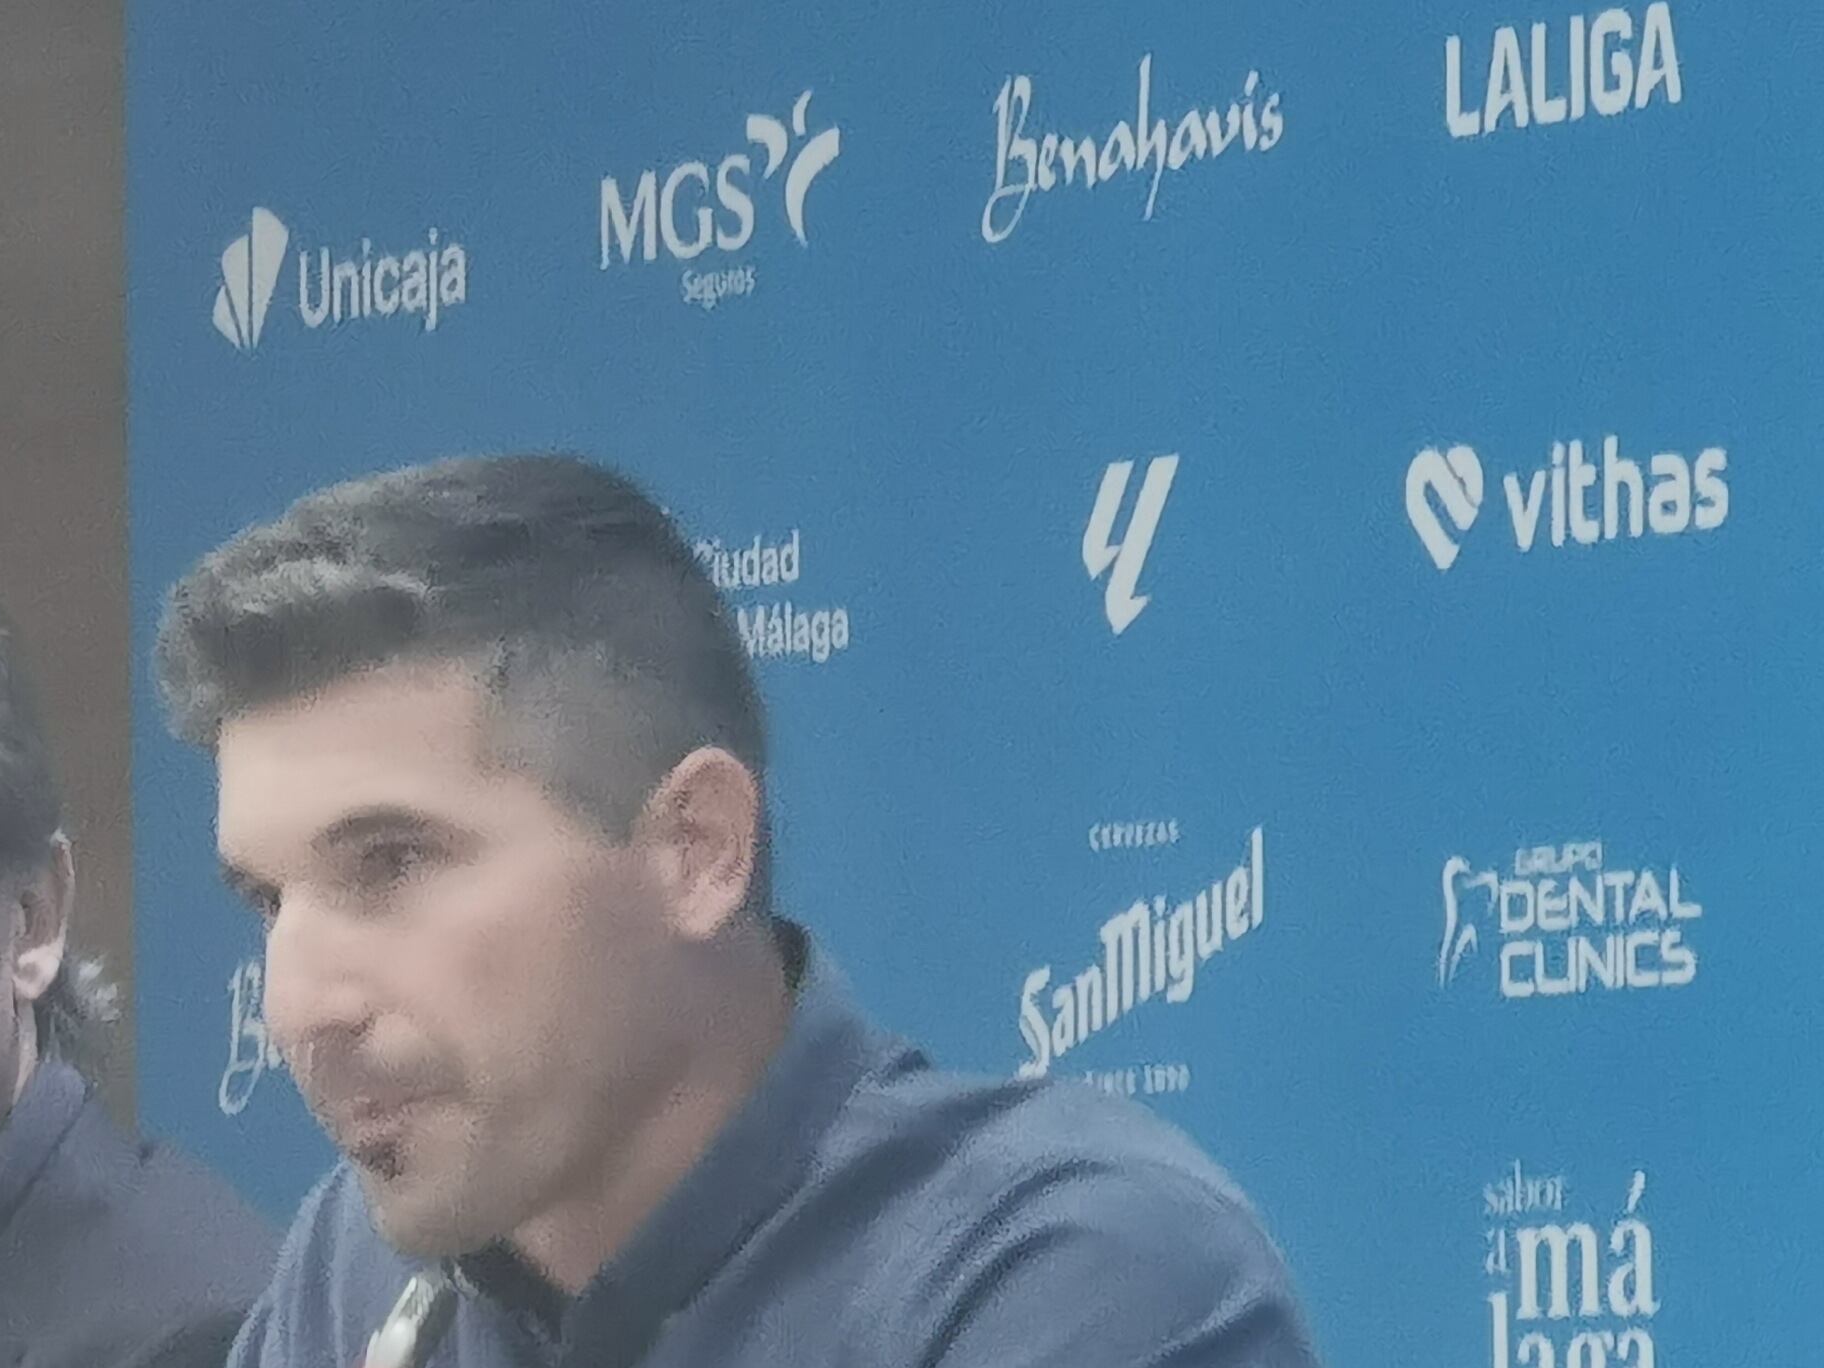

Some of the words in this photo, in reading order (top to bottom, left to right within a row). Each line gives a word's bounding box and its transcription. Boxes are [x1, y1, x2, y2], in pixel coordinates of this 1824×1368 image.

[1445, 1, 1682, 138] LALIGA
[600, 154, 755, 271] MGS
[299, 227, 466, 331] Unicaja
[1503, 435, 1729, 552] vithas
[737, 601, 849, 664] Málaga
[1500, 864, 1702, 933] DENTAL
[1500, 930, 1696, 998] CLINICS
[1516, 1169, 1662, 1320] má
